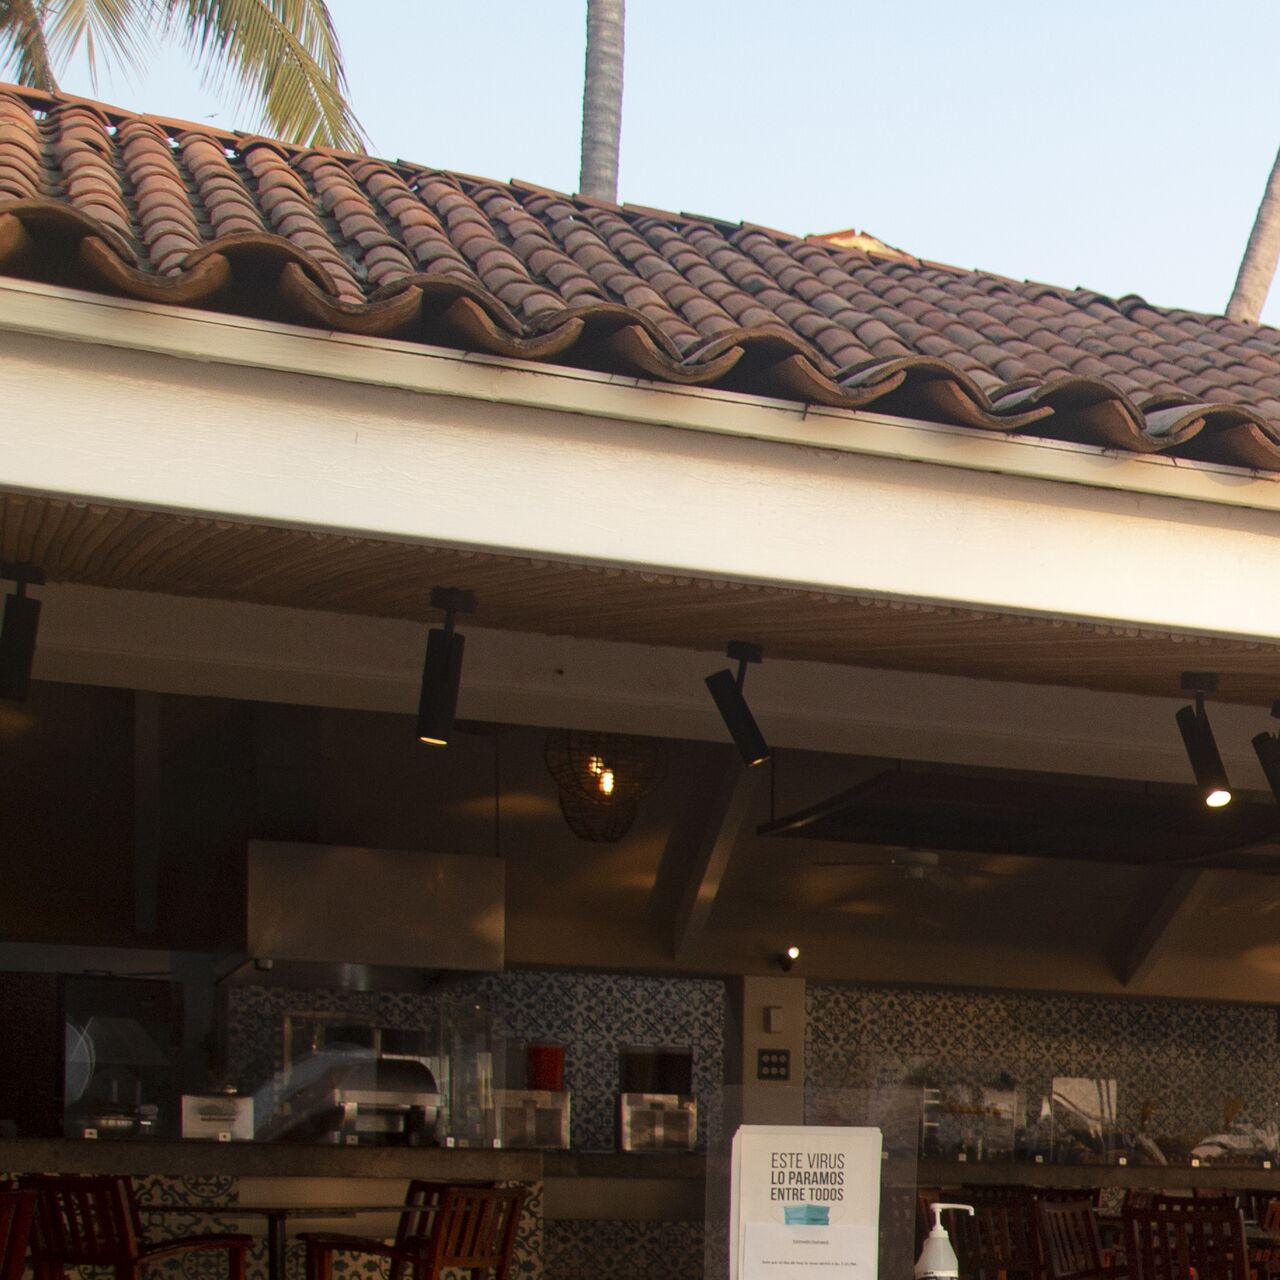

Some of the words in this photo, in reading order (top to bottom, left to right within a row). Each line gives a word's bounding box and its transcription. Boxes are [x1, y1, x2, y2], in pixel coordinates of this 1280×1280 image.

[772, 1152, 803, 1169] ESTE
[807, 1153, 845, 1169] VIRUS
[771, 1171, 785, 1185] LO
[788, 1171, 844, 1185] PARAMOS
[771, 1187, 805, 1201] ENTRE
[809, 1187, 844, 1201] TODOS
